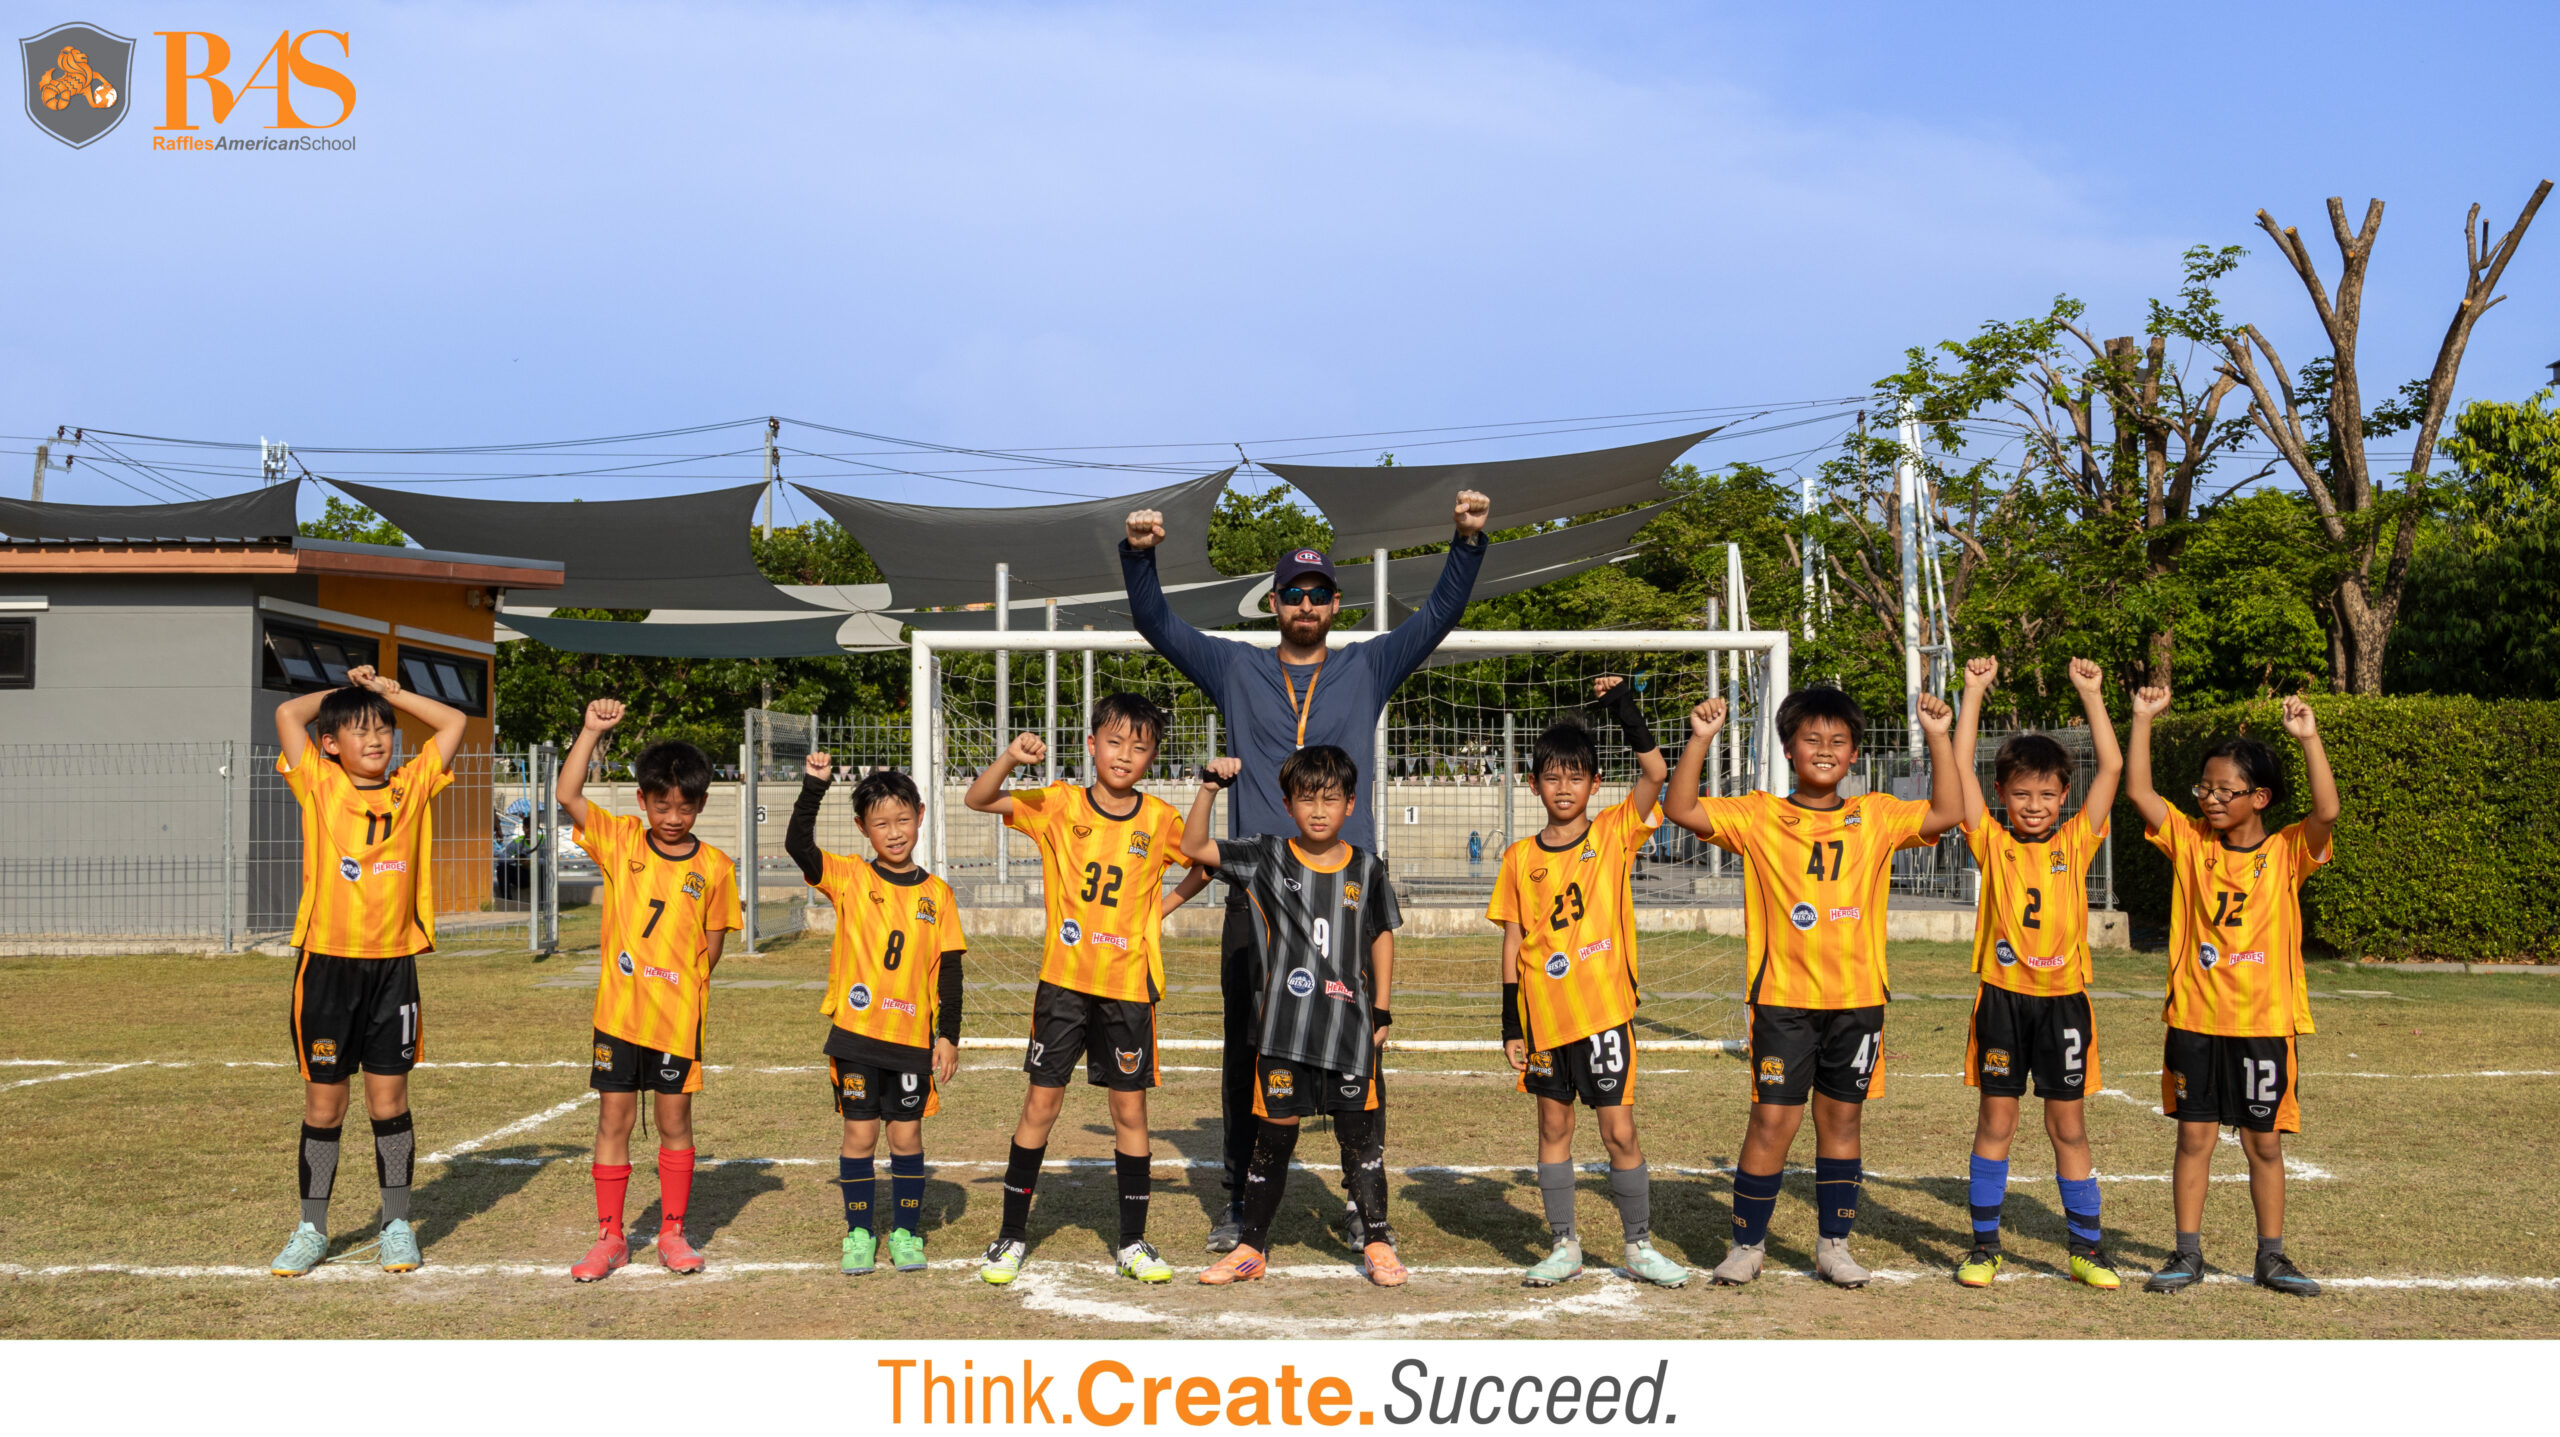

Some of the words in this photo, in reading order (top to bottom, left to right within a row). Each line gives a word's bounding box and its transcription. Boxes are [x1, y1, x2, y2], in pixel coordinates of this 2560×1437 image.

[1406, 806, 1414, 823] 1
[366, 809, 393, 846] 11
[374, 861, 406, 874] HEROES
[1806, 840, 1844, 881] 47
[1081, 861, 1124, 908] 32
[1550, 882, 1585, 931] 23
[1831, 908, 1860, 920] HEROES
[2022, 887, 2041, 929] 2
[2213, 891, 2249, 927] 12
[642, 898, 666, 939] 7
[1092, 932, 1128, 950] HEROES
[1313, 917, 1330, 959] 9
[883, 929, 905, 971] 8
[1580, 939, 1611, 960] HEROES
[2230, 951, 2264, 966] HEROES
[2029, 955, 2063, 967] HEROES
[645, 966, 679, 984] HEROES
[882, 1000, 916, 1015] HEROES
[400, 1002, 418, 1046] 11
[1590, 1030, 1624, 1073] 23
[2063, 1028, 2082, 1070] 2
[1761, 1073, 1783, 1083] RAPTORS
[1985, 1064, 2009, 1075] RAPTORS
[2243, 1057, 2277, 1101] 12
[1269, 1087, 1293, 1095] RAPTORS
[848, 1201, 868, 1211] GB
[900, 1198, 919, 1208] GB
[1837, 1208, 1856, 1218] GB
